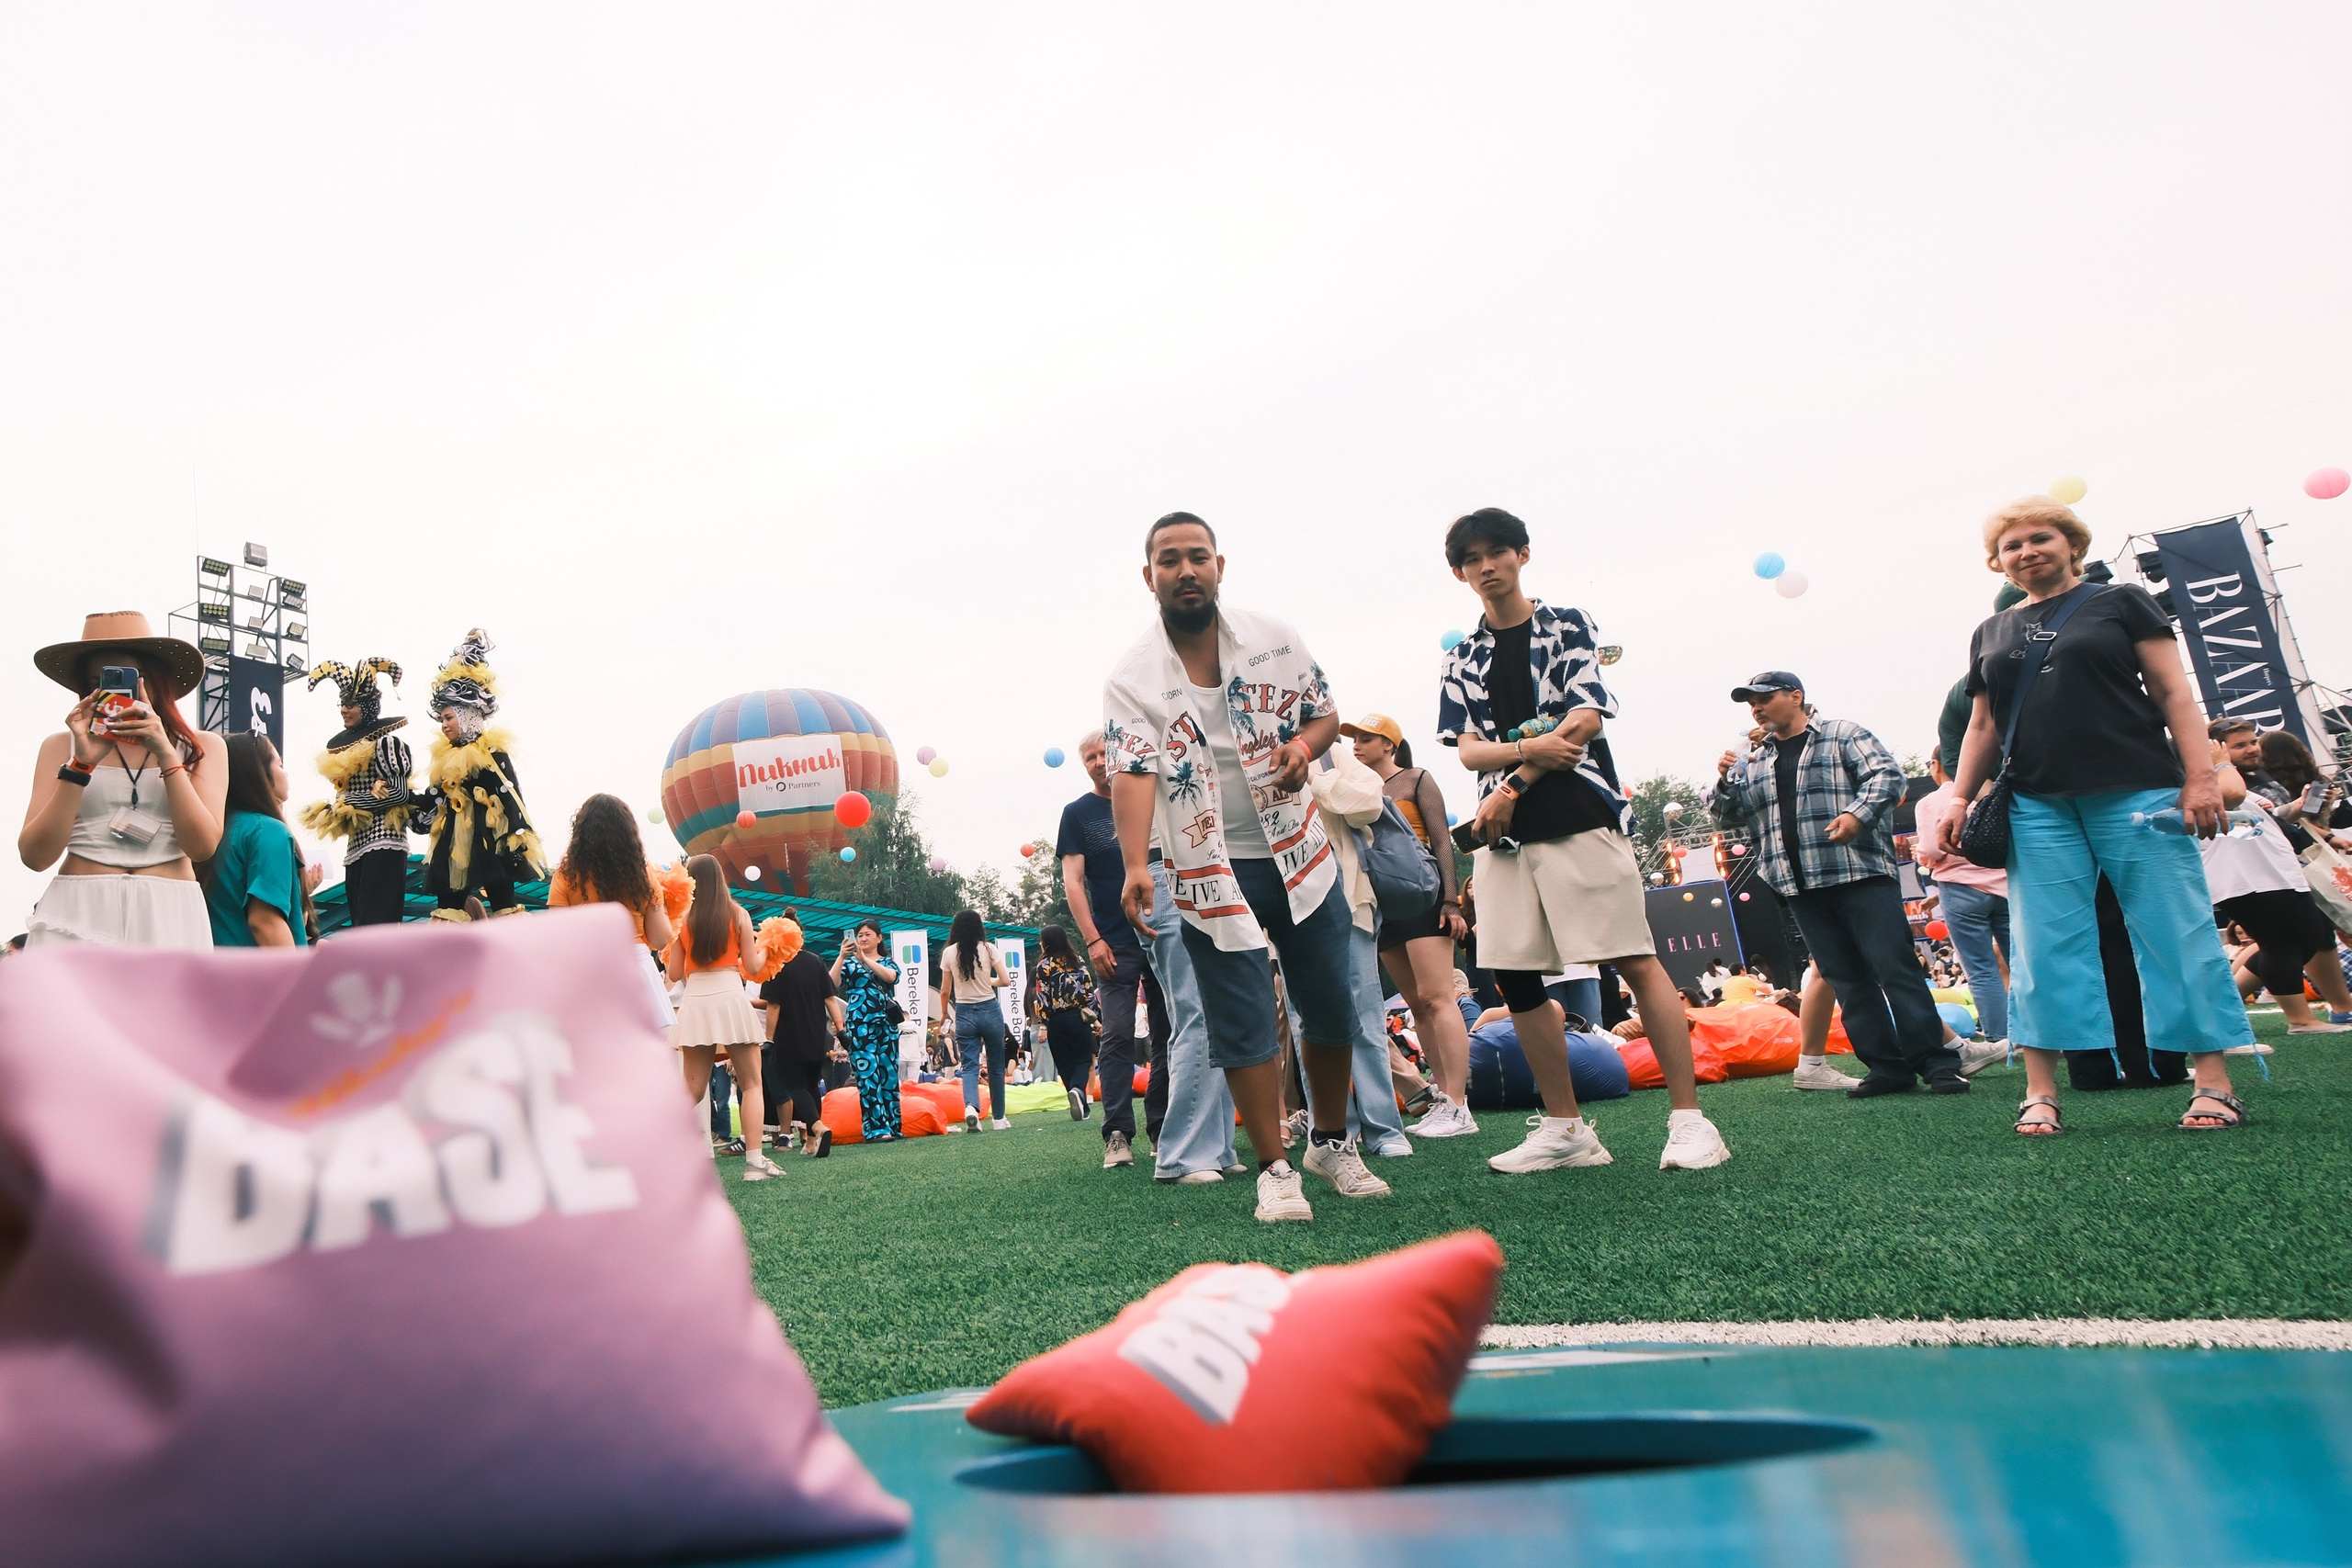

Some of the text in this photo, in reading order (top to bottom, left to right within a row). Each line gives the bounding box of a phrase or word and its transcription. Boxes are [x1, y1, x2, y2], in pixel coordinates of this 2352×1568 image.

[1249, 645, 1292, 667] GOOD TIME
[739, 747, 841, 788] Пикник
[764, 781, 821, 794] by Partners
[1668, 932, 1722, 953] ELLE
[906, 967, 922, 1016] Bereke
[1008, 971, 1022, 1015] Bereke
